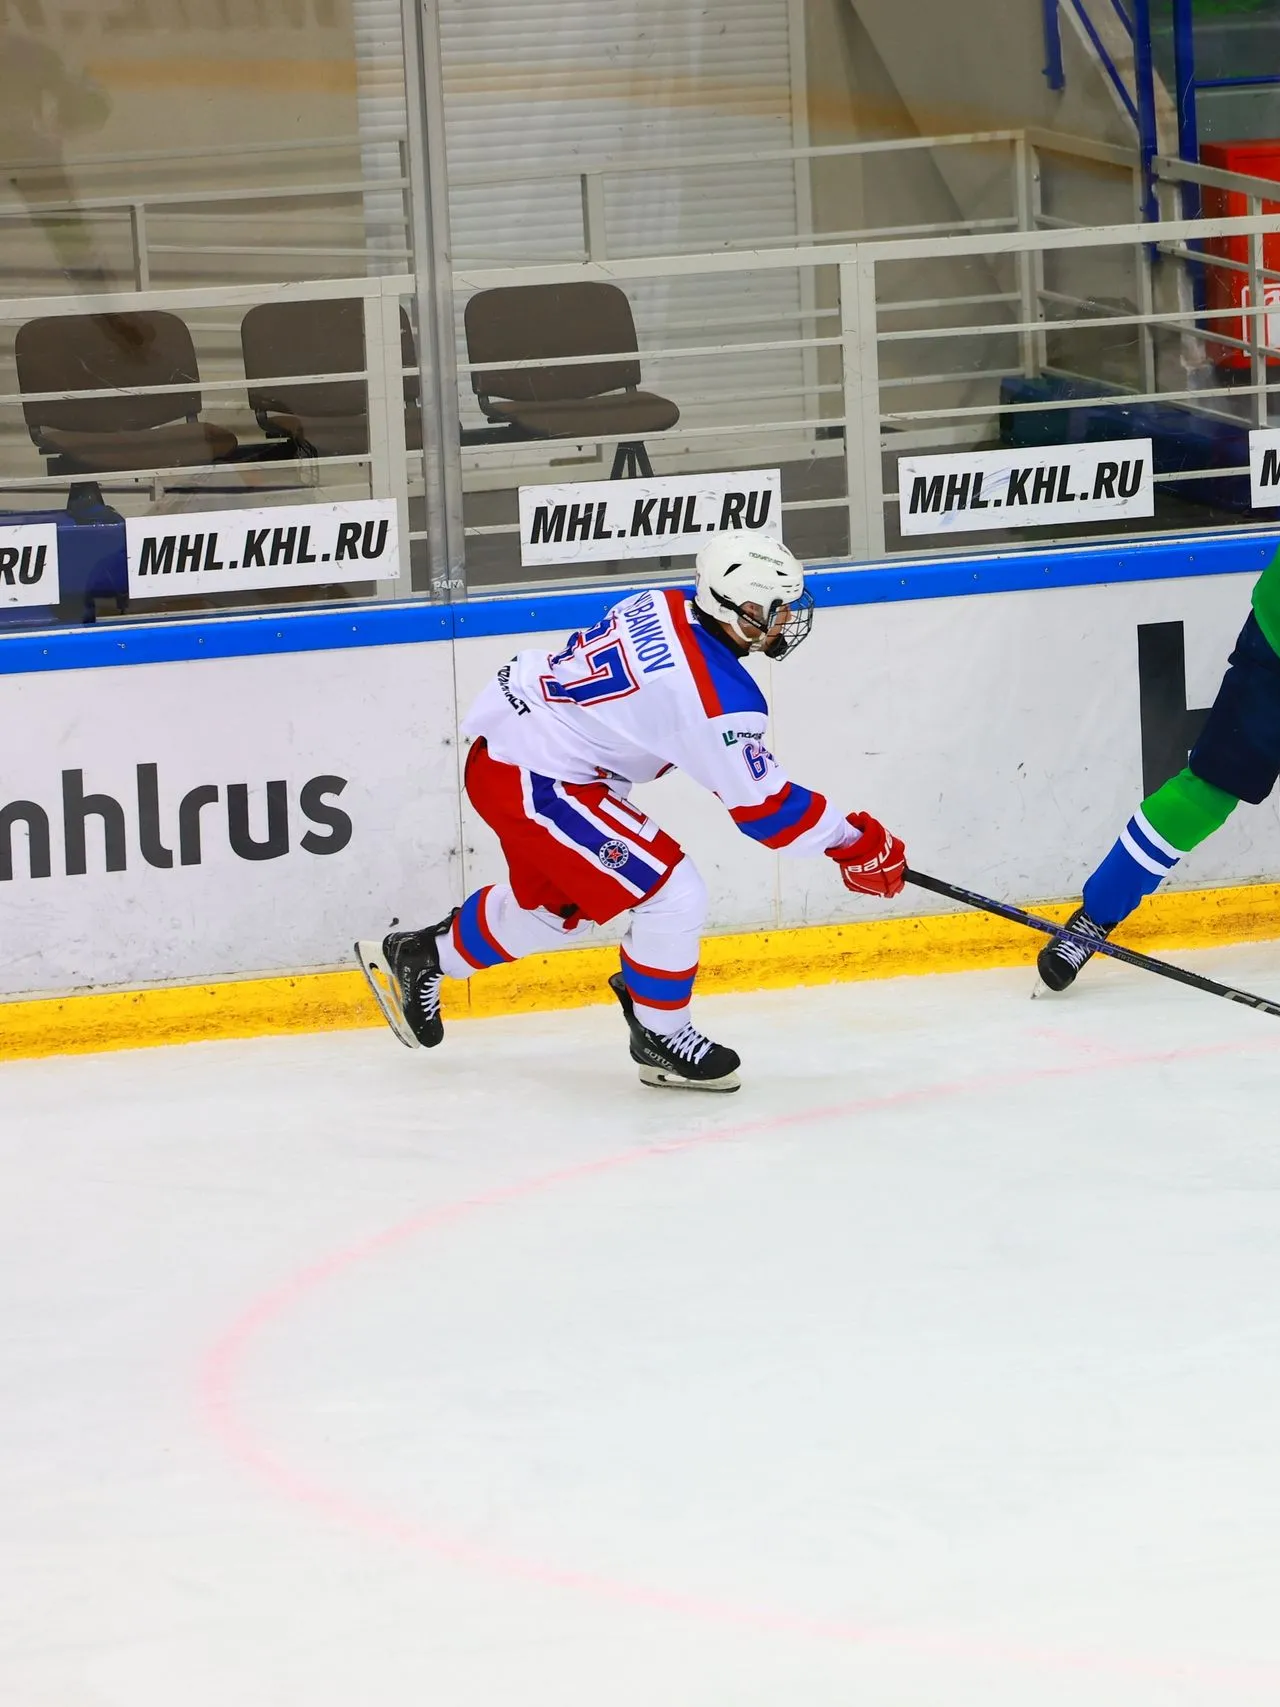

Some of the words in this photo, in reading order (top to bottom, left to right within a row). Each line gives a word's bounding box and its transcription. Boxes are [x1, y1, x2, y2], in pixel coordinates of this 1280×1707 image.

[909, 459, 1144, 515] MHL.KHL.RU
[530, 490, 772, 544] MHL.KHL.RU
[138, 520, 389, 576] MHL.KHL.RU
